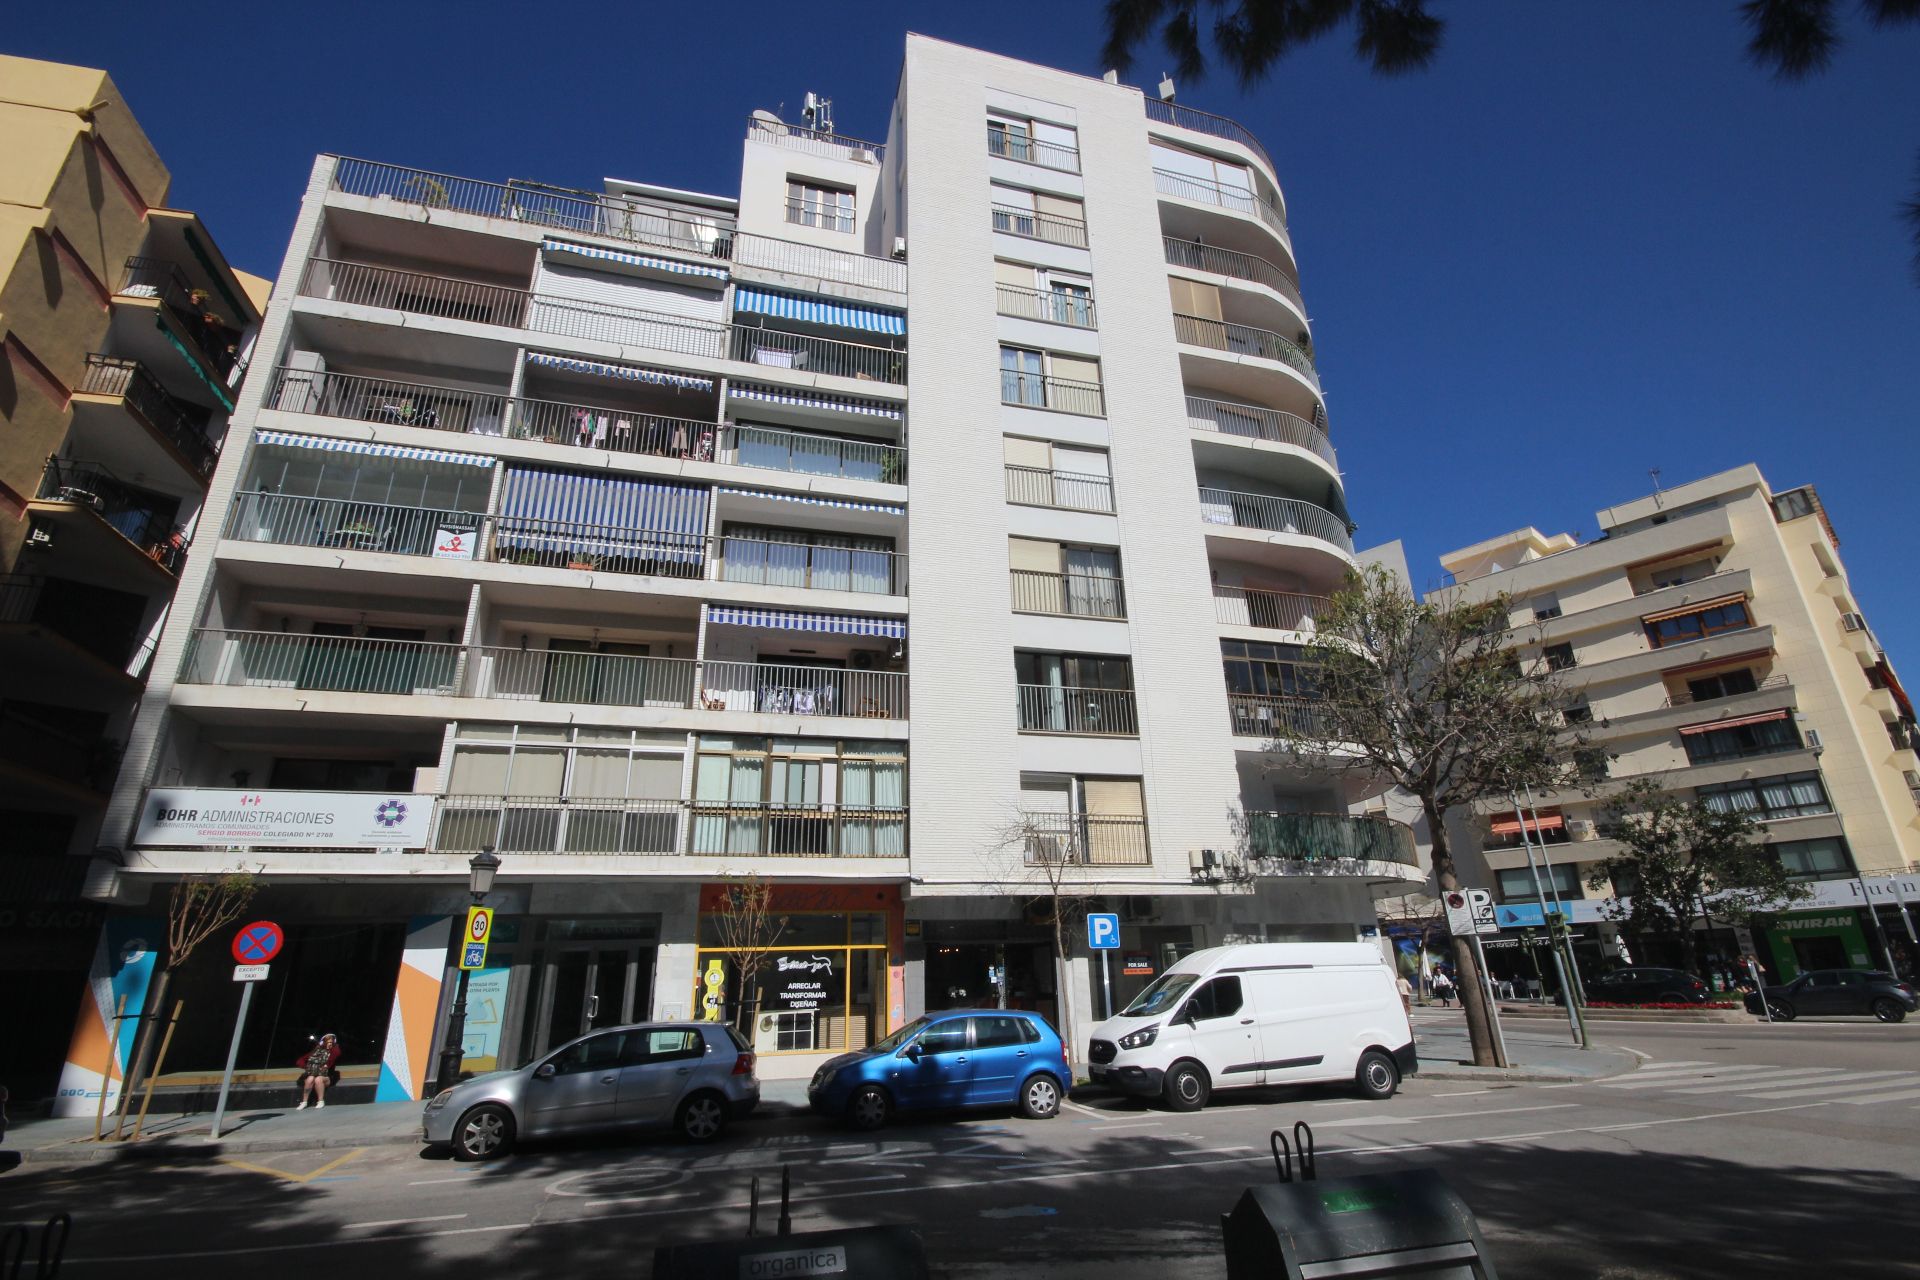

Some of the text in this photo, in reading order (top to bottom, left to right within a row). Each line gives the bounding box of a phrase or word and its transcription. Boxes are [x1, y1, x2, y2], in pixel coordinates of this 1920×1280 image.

[156, 808, 335, 825] BOHR ADMINISTRACIONES
[1468, 890, 1490, 919] P
[474, 920, 485, 931] 30
[1094, 917, 1113, 945] P
[788, 982, 821, 990] ARREGLAR
[779, 991, 827, 999] TRANSFORMAR
[790, 999, 818, 1008] DISEÑAR
[750, 1251, 837, 1277] organica
